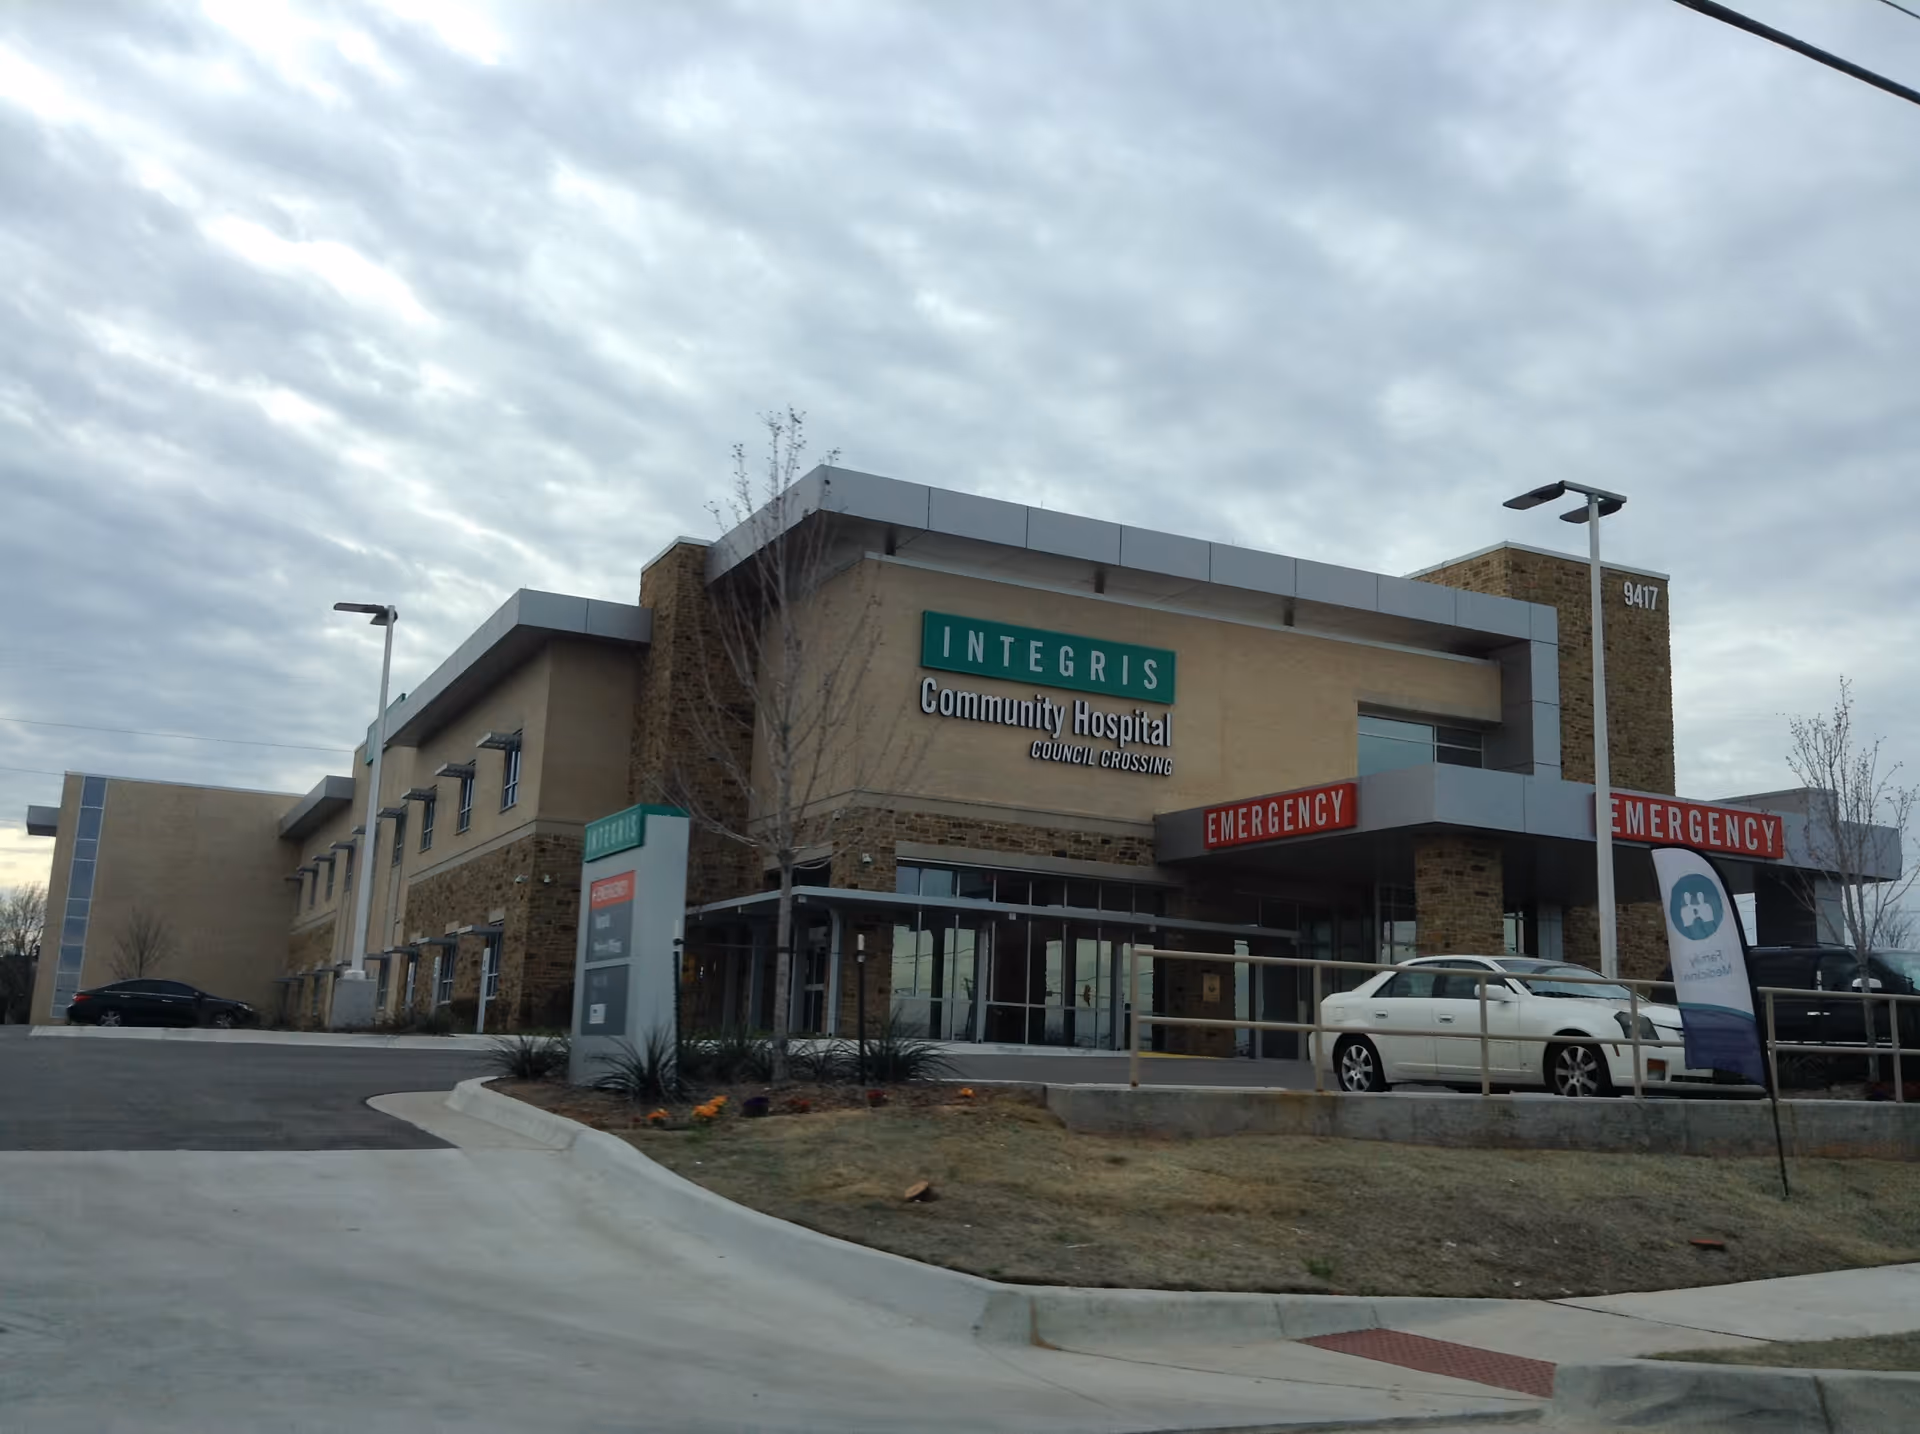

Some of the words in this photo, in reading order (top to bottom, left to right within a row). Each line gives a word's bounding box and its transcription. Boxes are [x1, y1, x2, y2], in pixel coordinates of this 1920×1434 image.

[1623, 581, 1659, 610] 9417
[943, 626, 1158, 690] INTEGRIS
[920, 676, 1066, 739] Community
[1072, 699, 1173, 748] Hospital
[1030, 740, 1096, 767] COUNCIL
[1100, 750, 1174, 777] CROSSING
[1207, 788, 1344, 844] EMERGENCY
[1609, 798, 1776, 853] EMERGENCY
